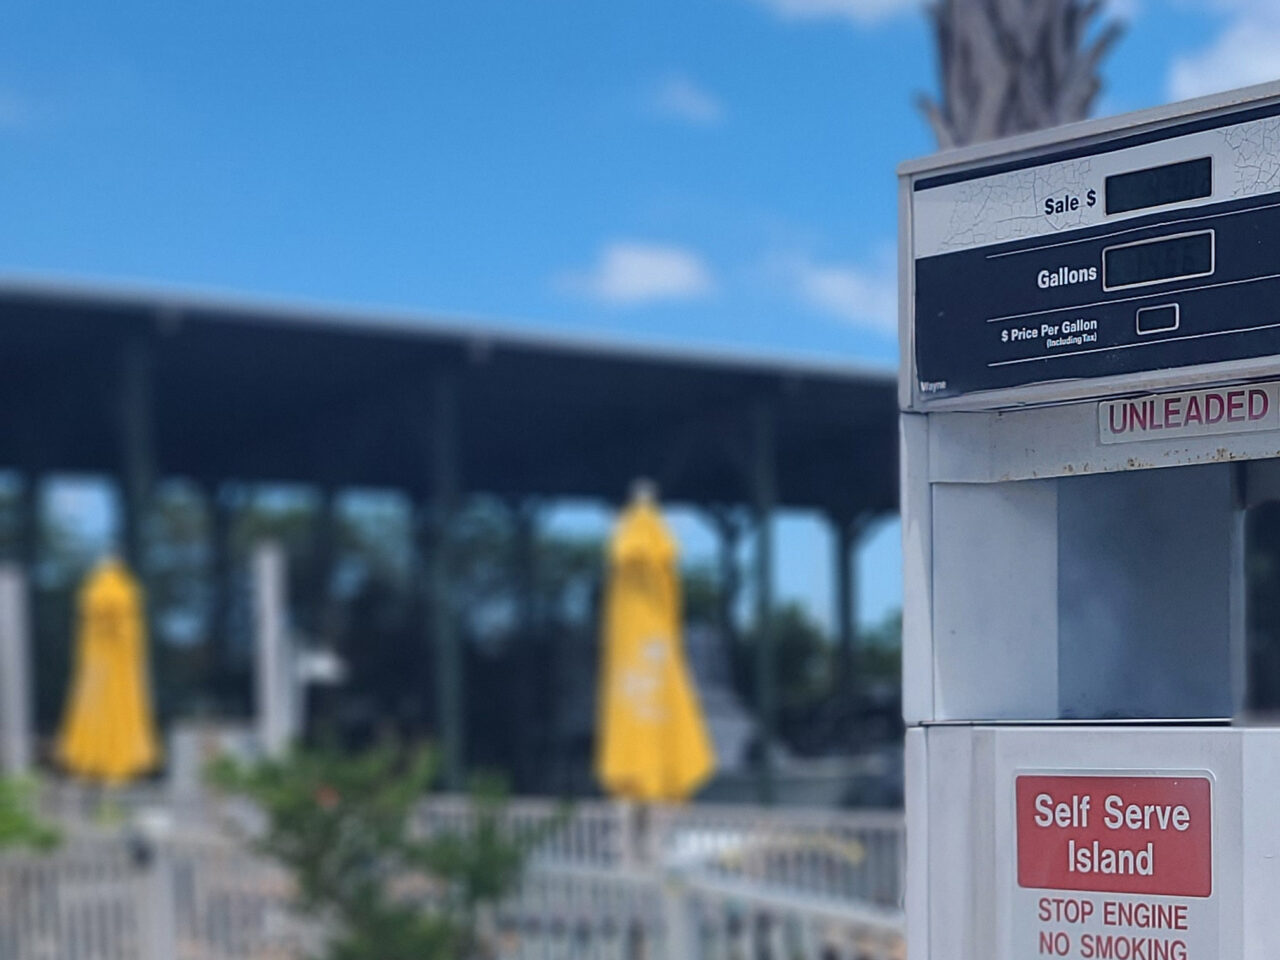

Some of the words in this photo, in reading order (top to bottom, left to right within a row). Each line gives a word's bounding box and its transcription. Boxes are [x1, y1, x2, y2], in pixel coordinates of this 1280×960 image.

[1044, 195, 1079, 215] Sale
[1086, 189, 1097, 207] $
[1037, 266, 1097, 289] Gallons
[1001, 329, 1009, 342] $
[1011, 327, 1038, 341] Price
[1041, 324, 1058, 337] Per
[1061, 319, 1097, 334] Gallon
[920, 381, 946, 393] Wayne
[1109, 389, 1269, 434] UNLEADED
[1034, 793, 1091, 828] Self
[1103, 795, 1191, 831] Serve
[1068, 839, 1154, 876] Island
[1038, 897, 1094, 924] STOP
[1103, 901, 1188, 930] ENGINE
[1039, 931, 1071, 956] NO
